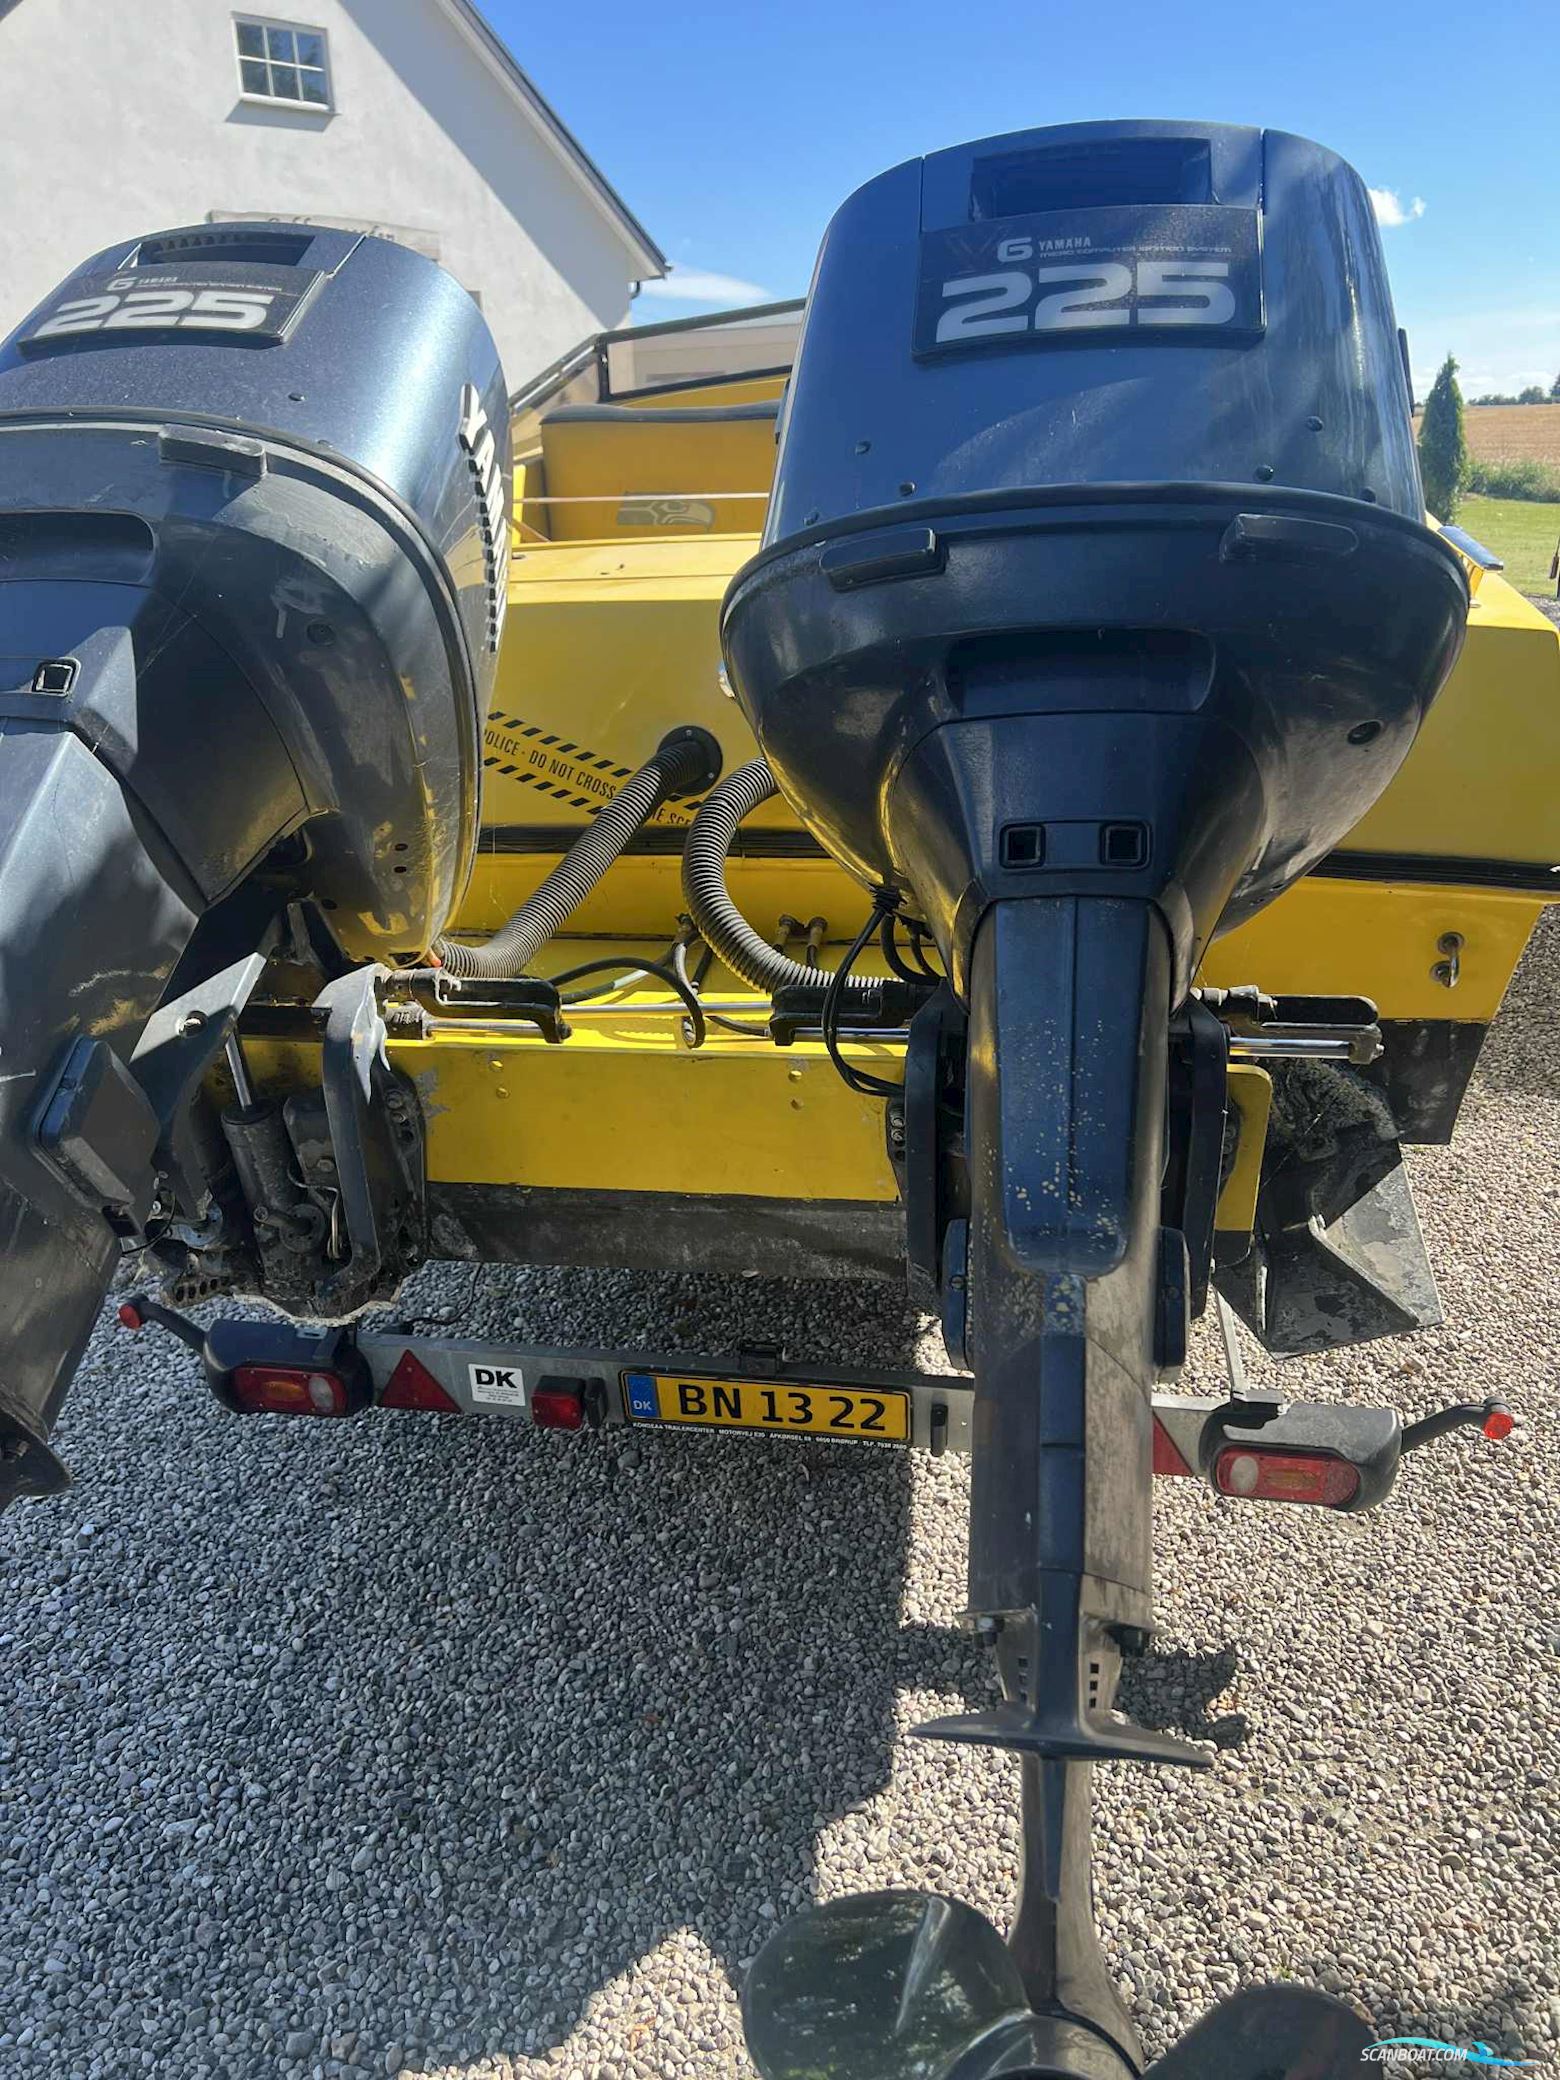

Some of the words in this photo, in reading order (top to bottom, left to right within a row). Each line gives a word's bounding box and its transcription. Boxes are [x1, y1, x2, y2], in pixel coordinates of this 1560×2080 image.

[1039, 236, 1092, 251] YAMAHA
[32, 290, 274, 337] 225
[936, 262, 1236, 343] 225
[529, 750, 546, 769] DO
[549, 757, 575, 782] NOT
[576, 771, 617, 800] CROSS
[475, 1369, 518, 1388] DK
[633, 1399, 652, 1411] DK
[679, 1384, 742, 1418] BN
[762, 1391, 813, 1424] 13
[829, 1397, 886, 1431] 22
